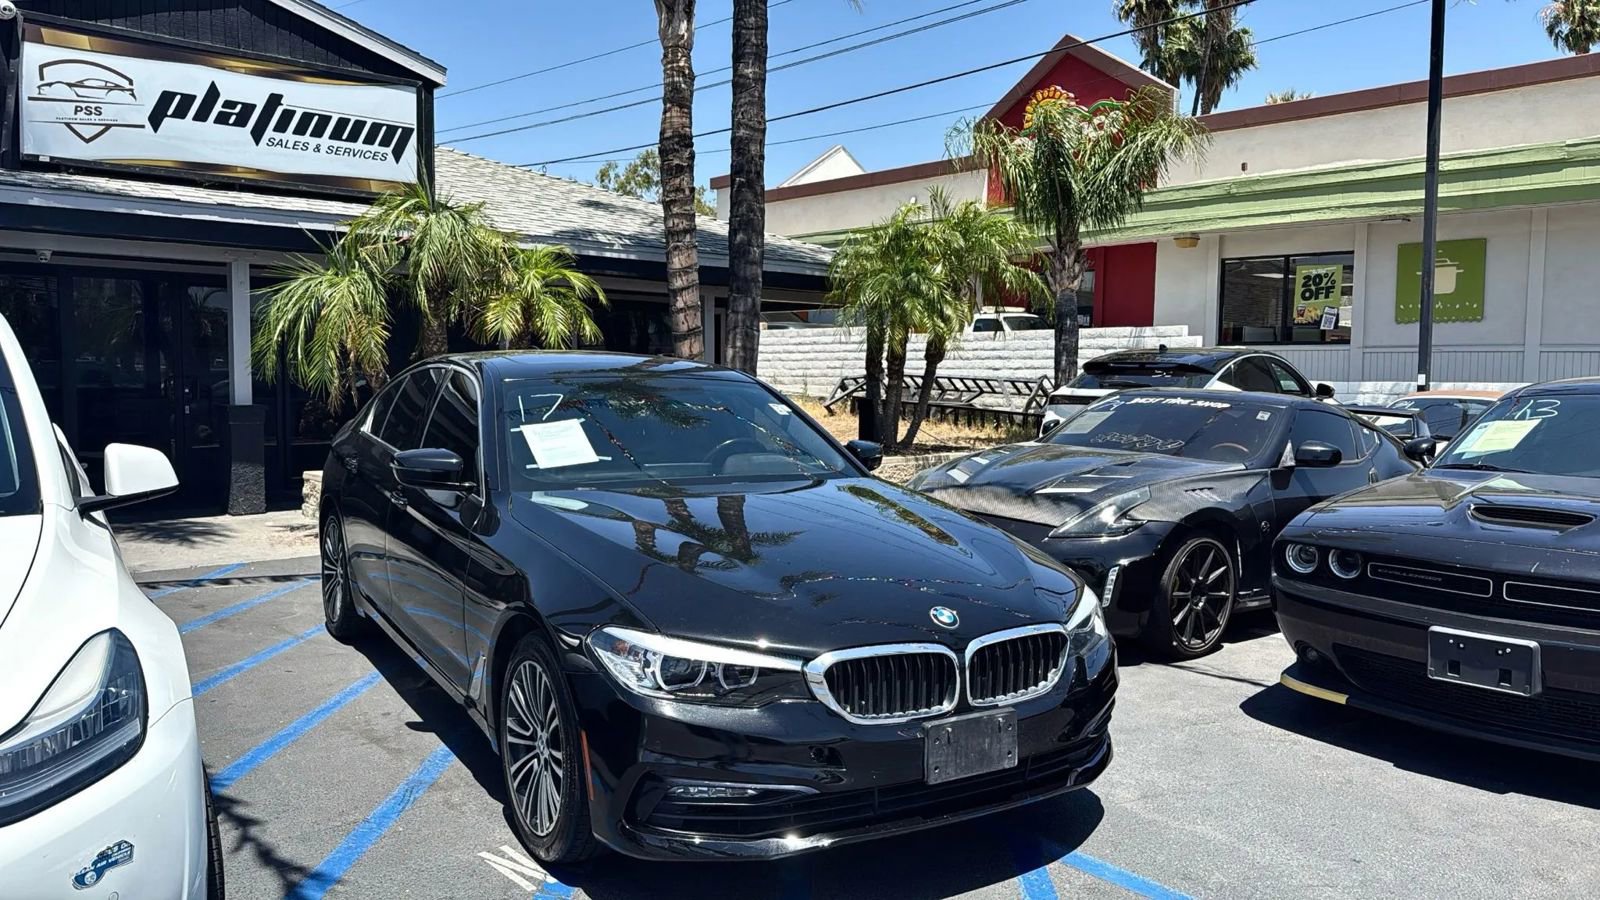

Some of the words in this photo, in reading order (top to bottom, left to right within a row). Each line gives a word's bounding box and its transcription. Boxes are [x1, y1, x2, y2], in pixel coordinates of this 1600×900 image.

[74, 105, 103, 116] PSS
[148, 80, 415, 165] platinum
[266, 137, 310, 151] SALES
[312, 143, 322, 153] &
[325, 144, 389, 162] SERVICES
[1301, 272, 1336, 288] 20%
[1301, 286, 1335, 301] OFF
